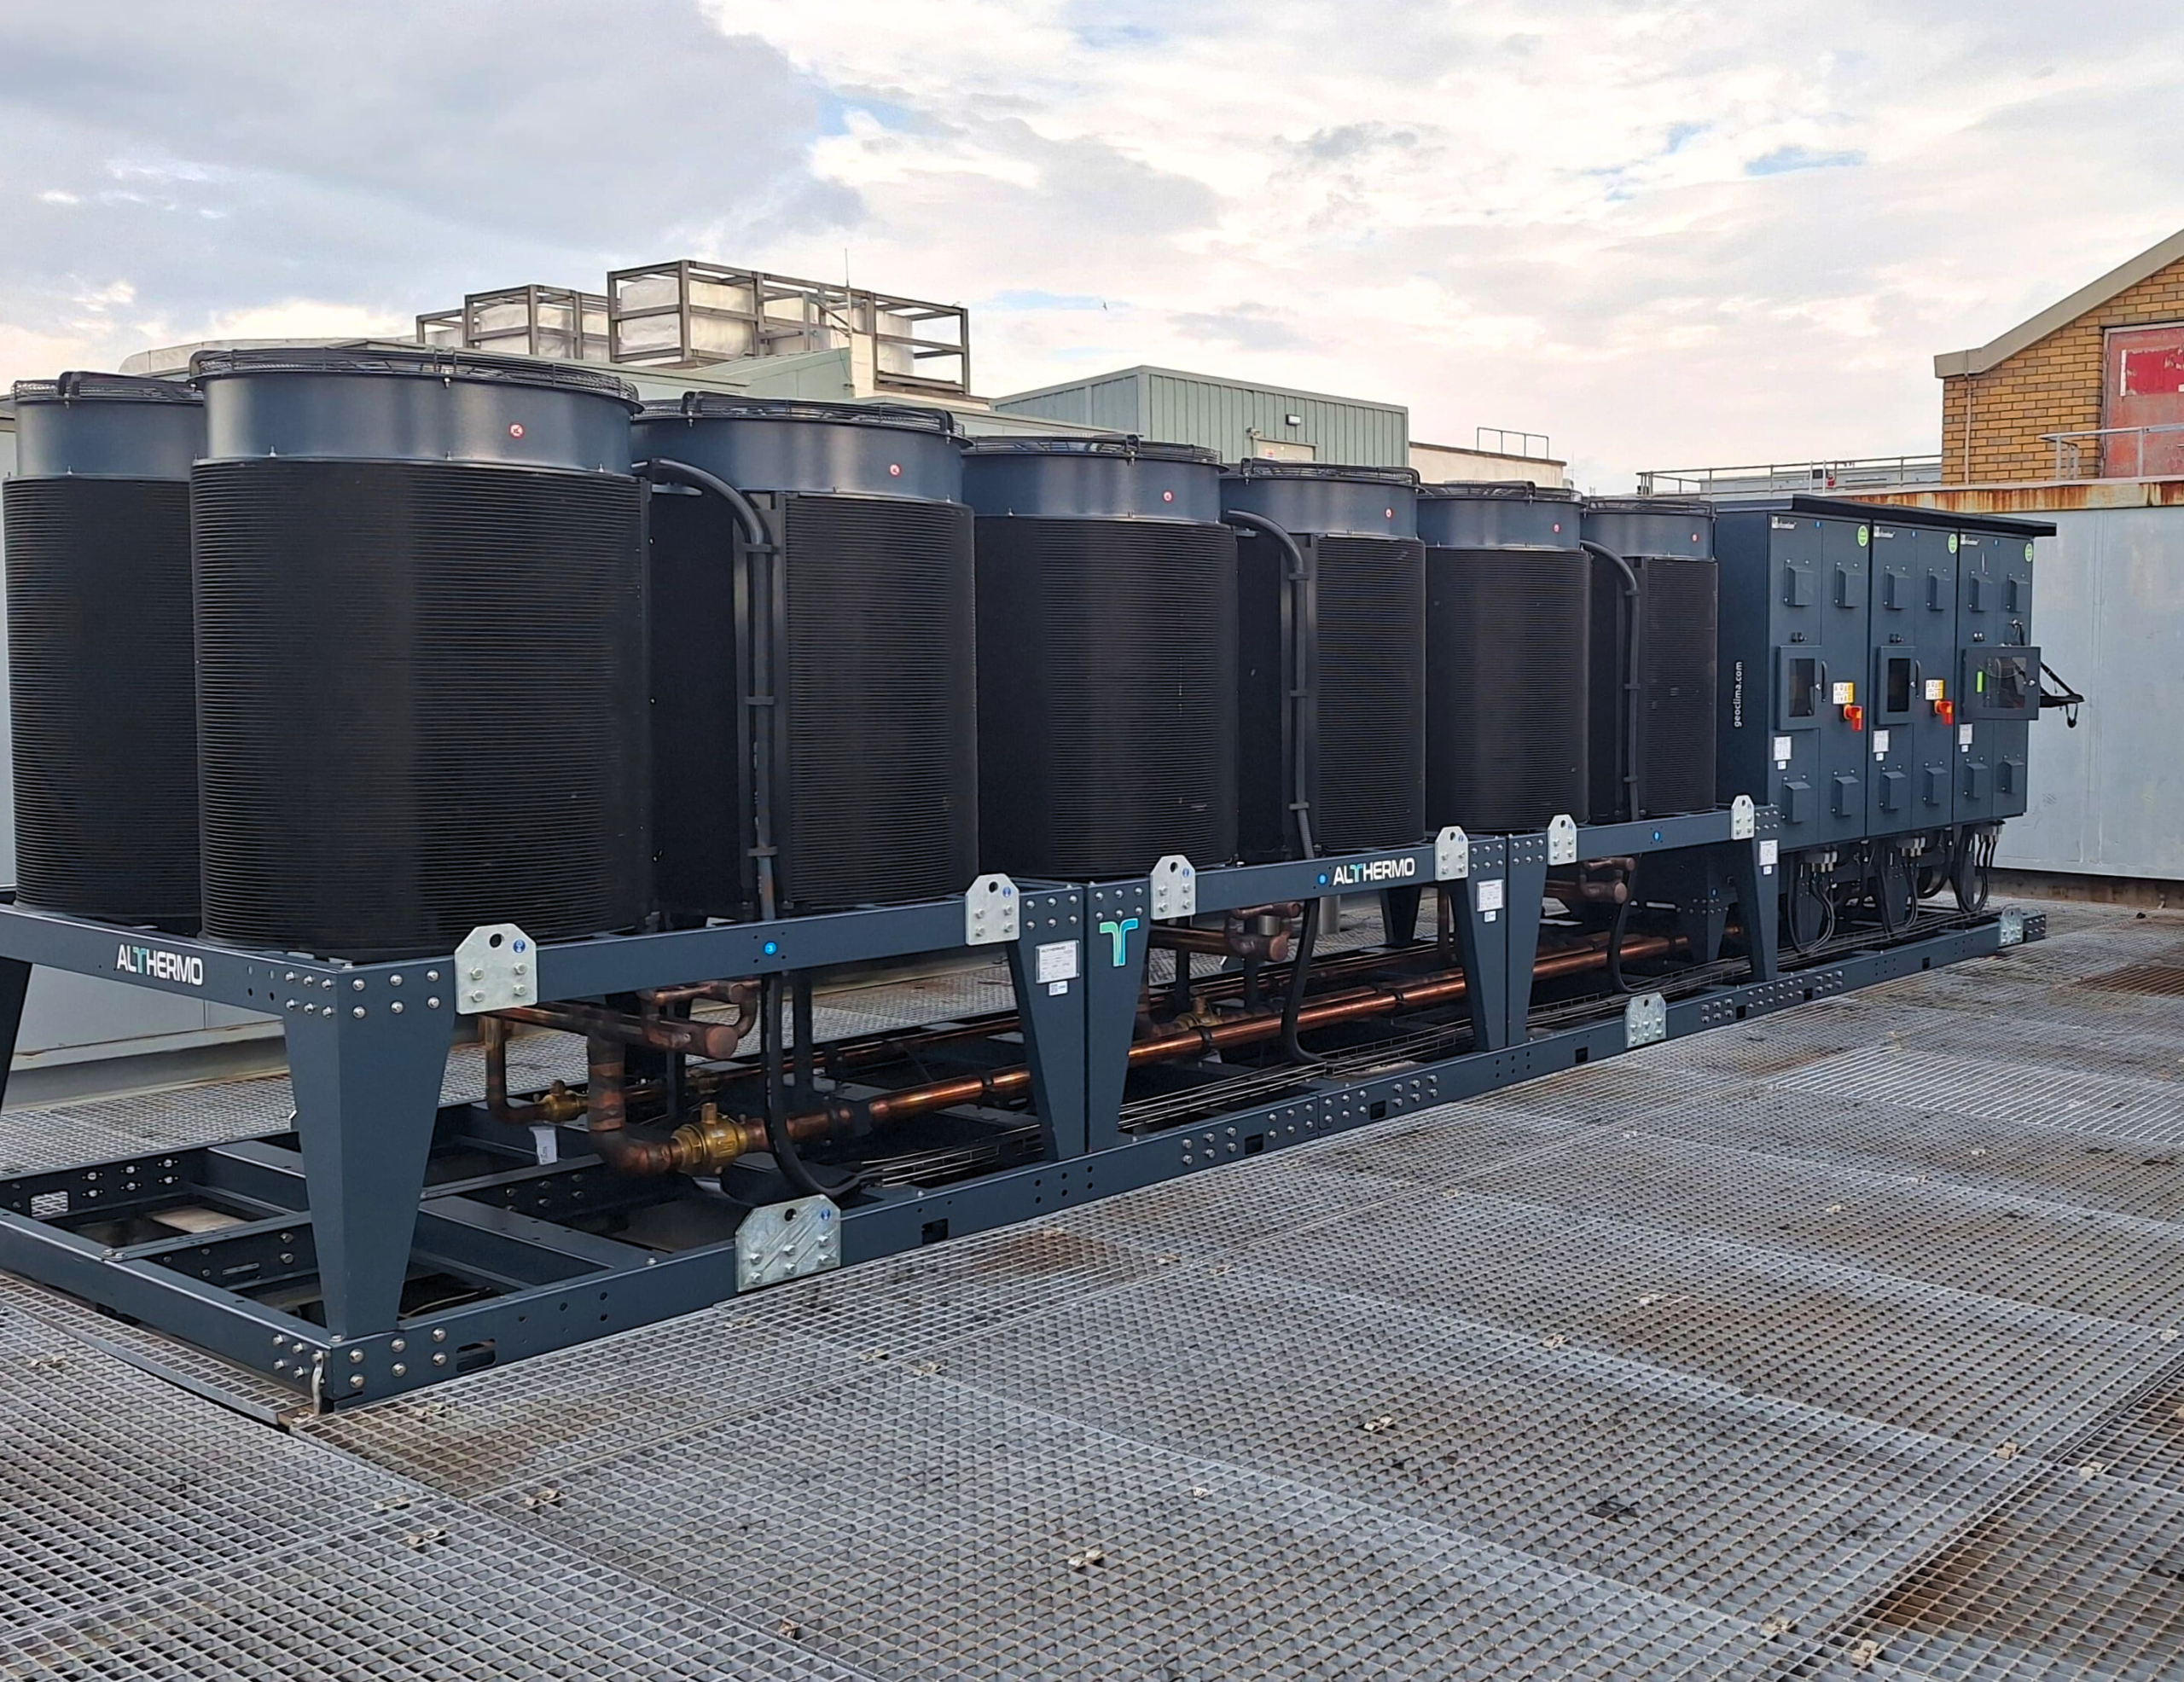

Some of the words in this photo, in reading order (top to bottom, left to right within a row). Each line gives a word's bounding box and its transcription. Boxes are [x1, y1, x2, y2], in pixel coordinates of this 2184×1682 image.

[1733, 661, 1743, 728] geoclima.com
[1333, 857, 1415, 886] ALTHERMO
[117, 943, 204, 986] ALTHERMO
